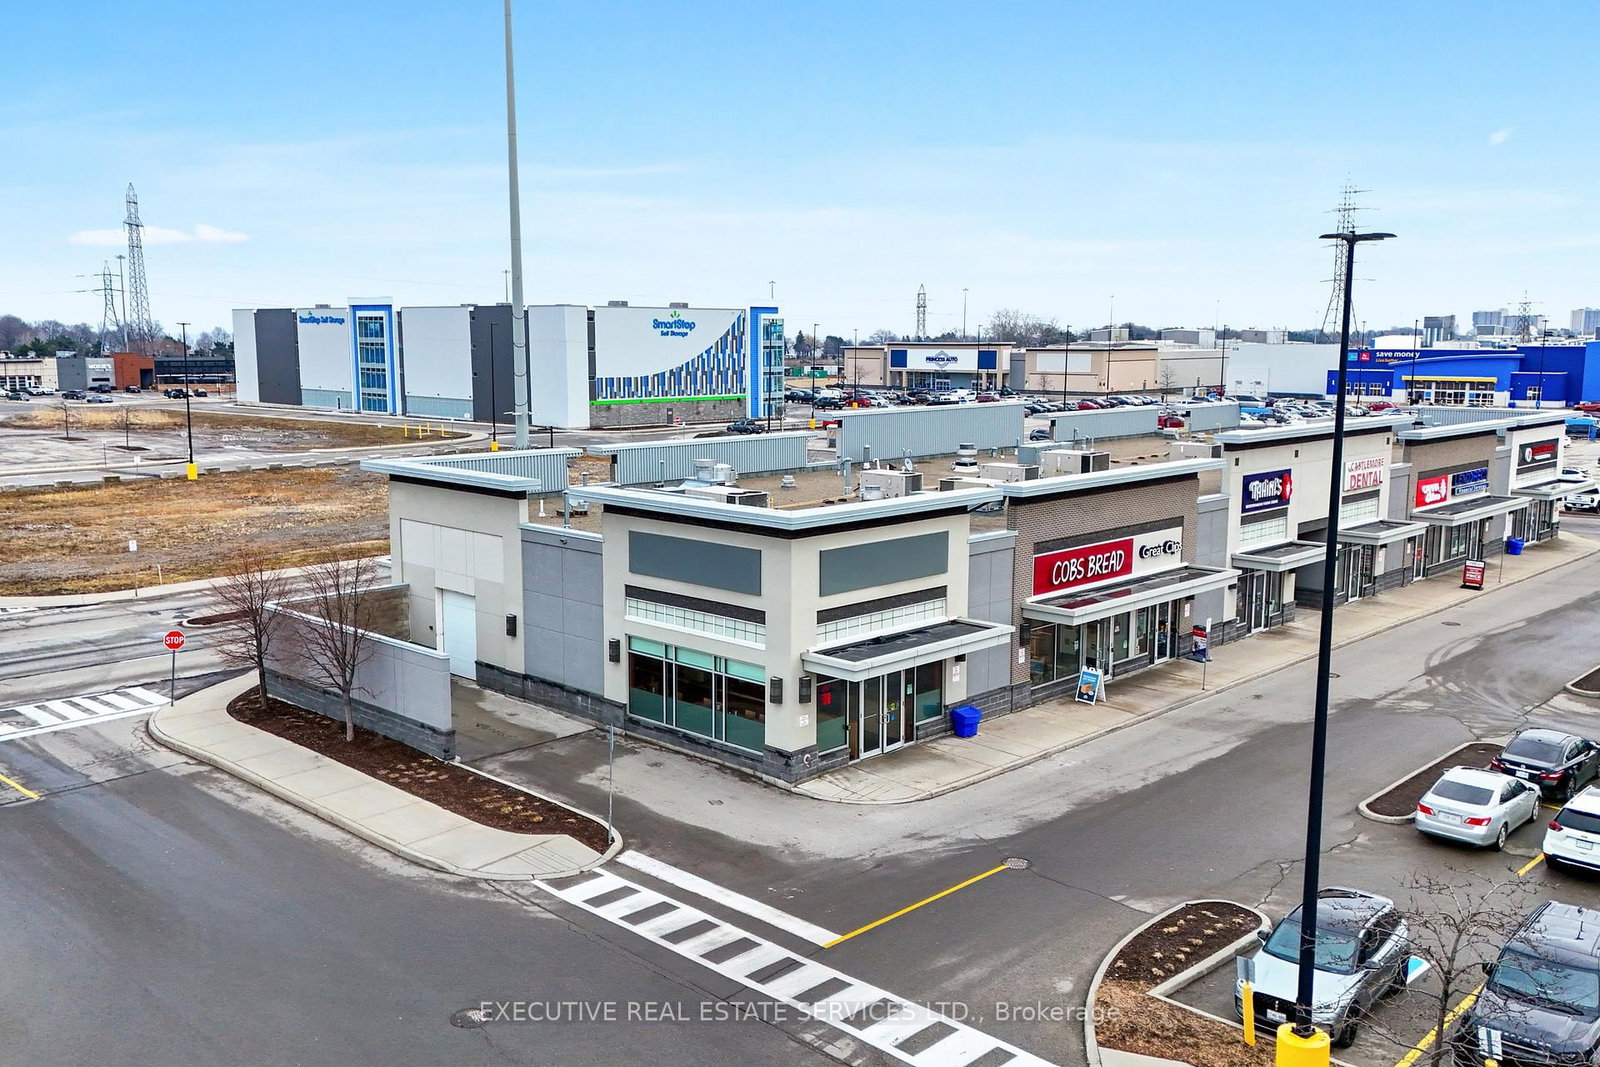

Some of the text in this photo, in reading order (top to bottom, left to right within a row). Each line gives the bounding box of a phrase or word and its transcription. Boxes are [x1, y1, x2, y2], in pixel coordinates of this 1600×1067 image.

[653, 319, 695, 331] SmartStop
[1350, 471, 1383, 489] DENTAL
[1140, 540, 1183, 558] Great Clips
[1052, 550, 1124, 585] COBS BREAD
[165, 636, 184, 644] STOP
